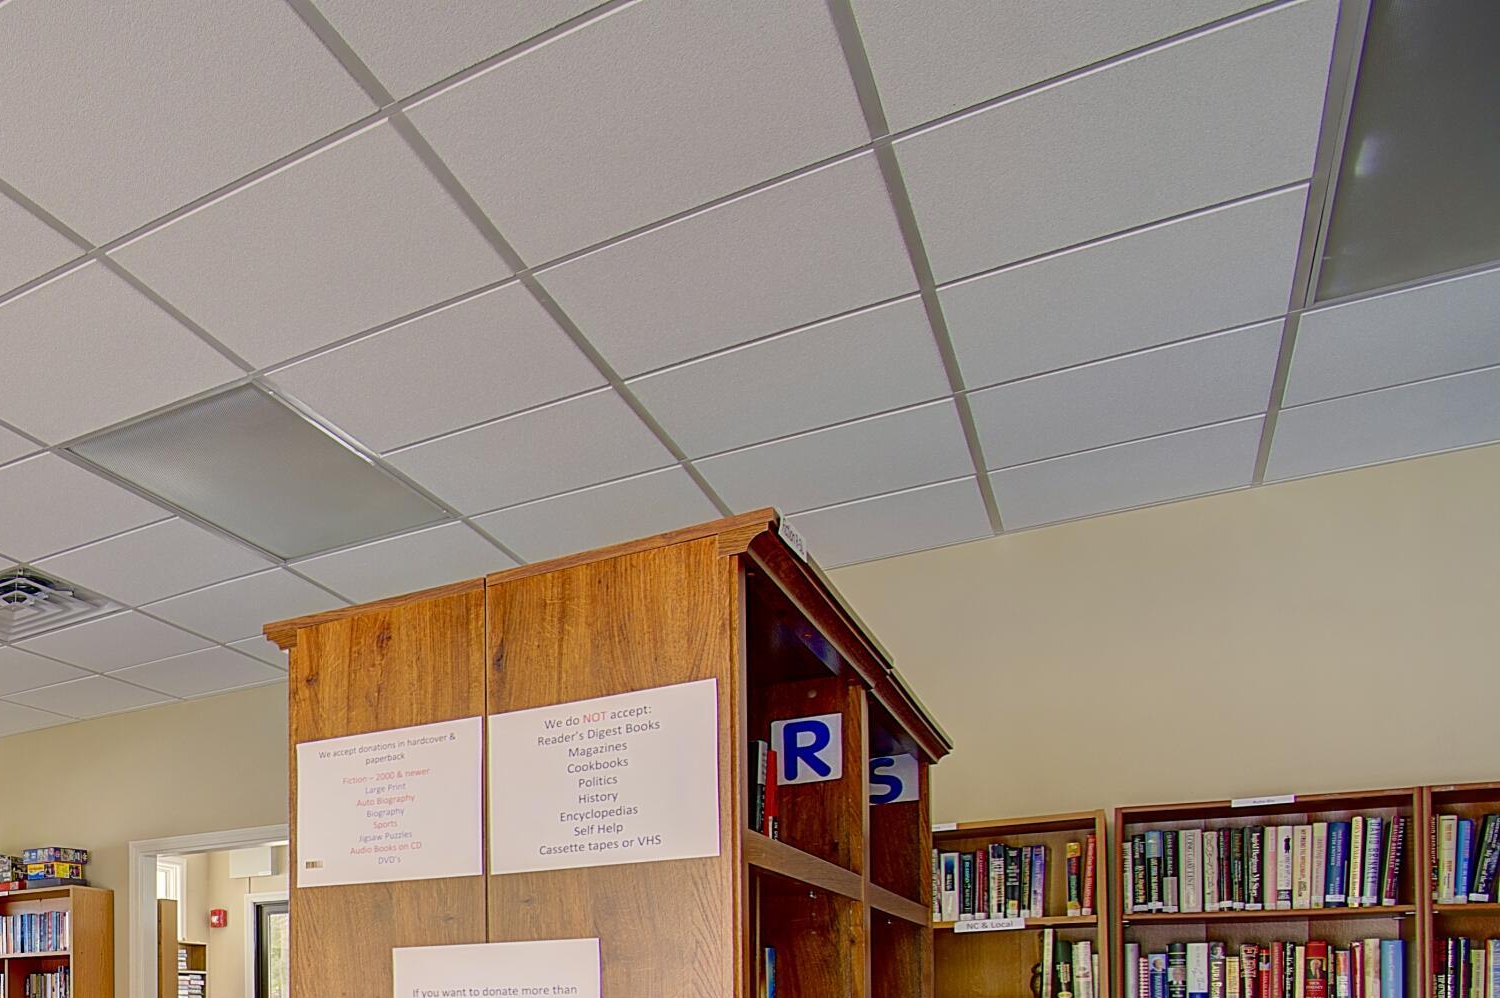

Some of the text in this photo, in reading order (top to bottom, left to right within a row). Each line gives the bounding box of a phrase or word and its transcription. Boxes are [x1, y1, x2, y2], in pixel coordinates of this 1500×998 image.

[544, 705, 652, 729] We do NOT accept:
[538, 720, 660, 746] Reader's Digest Books
[318, 732, 456, 759] We accept donations in hardcover &
[568, 741, 628, 758] Magazines
[782, 720, 832, 782] R
[365, 752, 405, 766] paperback
[567, 757, 628, 774] Cookbooks
[342, 775, 367, 784] Fiction
[375, 771, 395, 781] 2000
[397, 770, 403, 778] &
[405, 767, 430, 777] newer
[578, 775, 618, 788] Politics
[869, 757, 903, 805] S
[365, 782, 406, 794] Large Print
[356, 794, 416, 807] Auto Biography
[578, 791, 618, 804] History
[366, 807, 405, 818] Biography
[560, 805, 638, 822] Encyclopedias
[373, 820, 397, 830] Sports
[574, 822, 623, 836] Self Help
[358, 830, 413, 844] Jigsaw Puzzles
[350, 846, 372, 855] Audio
[374, 844, 396, 853] Books
[410, 841, 422, 850] CD
[539, 834, 661, 855] Cassette tapes or VHS
[1388, 824, 1399, 869] DAVID BRINKLEY
[1167, 848, 1172, 856] OF
[1366, 821, 1381, 884] DAVID BRINKLEY
[1484, 849, 1493, 857] My
[1186, 834, 1195, 887] LONG GRAY LINE
[1251, 832, 1260, 897] Ingrid Bergman My Story
[1393, 858, 1401, 874] BEAT
[1483, 858, 1491, 870] Share
[1478, 883, 1486, 893] Task
[991, 920, 1013, 929] Local
[1286, 943, 1294, 957] Now
[1286, 957, 1294, 966] It's
[1284, 966, 1293, 976] My
[1211, 961, 1223, 998] LAURA BUSH
[412, 988, 420, 998] If
[442, 988, 466, 997] want
[468, 988, 480, 997] to
[482, 987, 519, 997] donate
[521, 985, 550, 996] more
[552, 984, 578, 995] than
